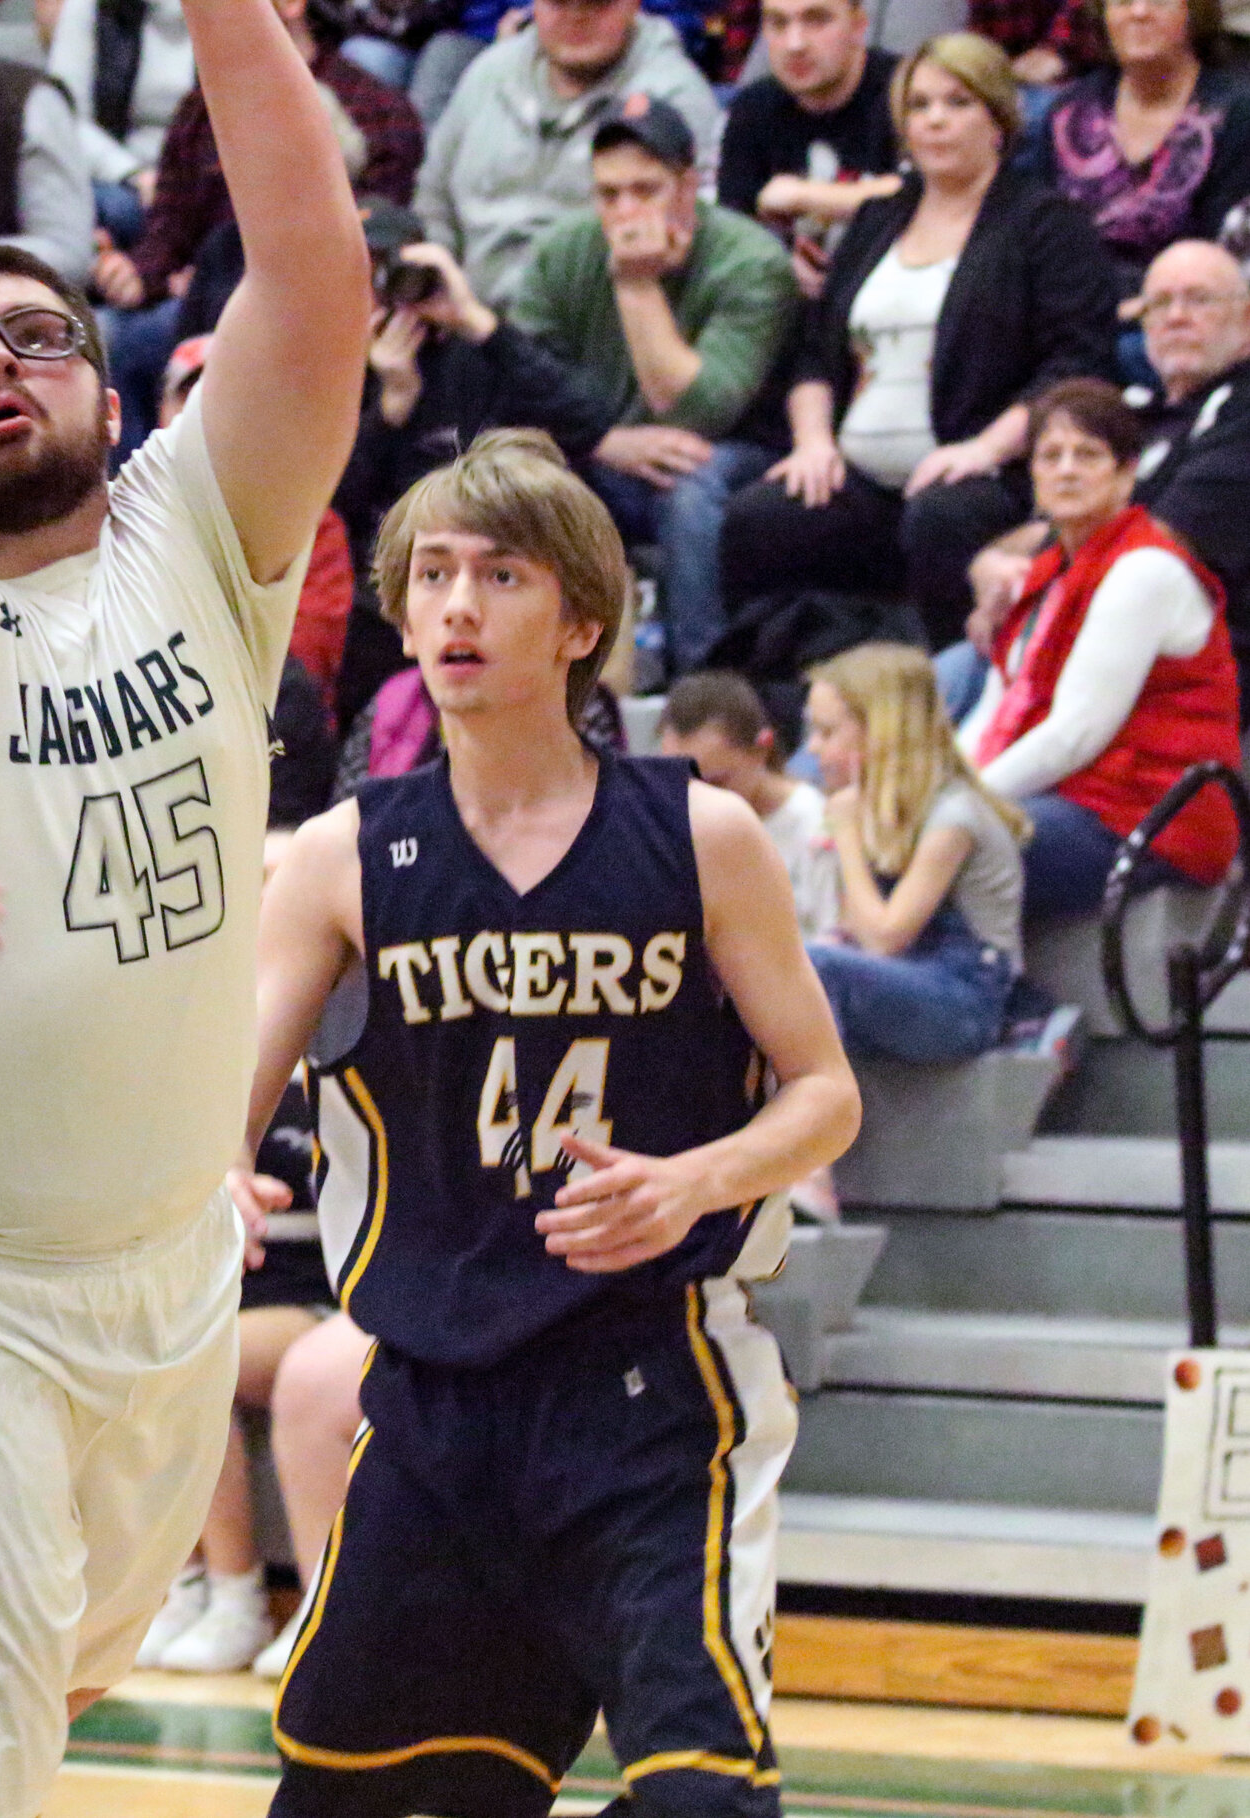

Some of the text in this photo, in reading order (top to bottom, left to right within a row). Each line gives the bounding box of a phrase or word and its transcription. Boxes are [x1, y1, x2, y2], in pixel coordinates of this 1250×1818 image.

[9, 630, 214, 765] JAGUARS
[62, 756, 225, 965] 45
[377, 930, 687, 1026] TIGERS
[477, 1036, 613, 1200] 44
